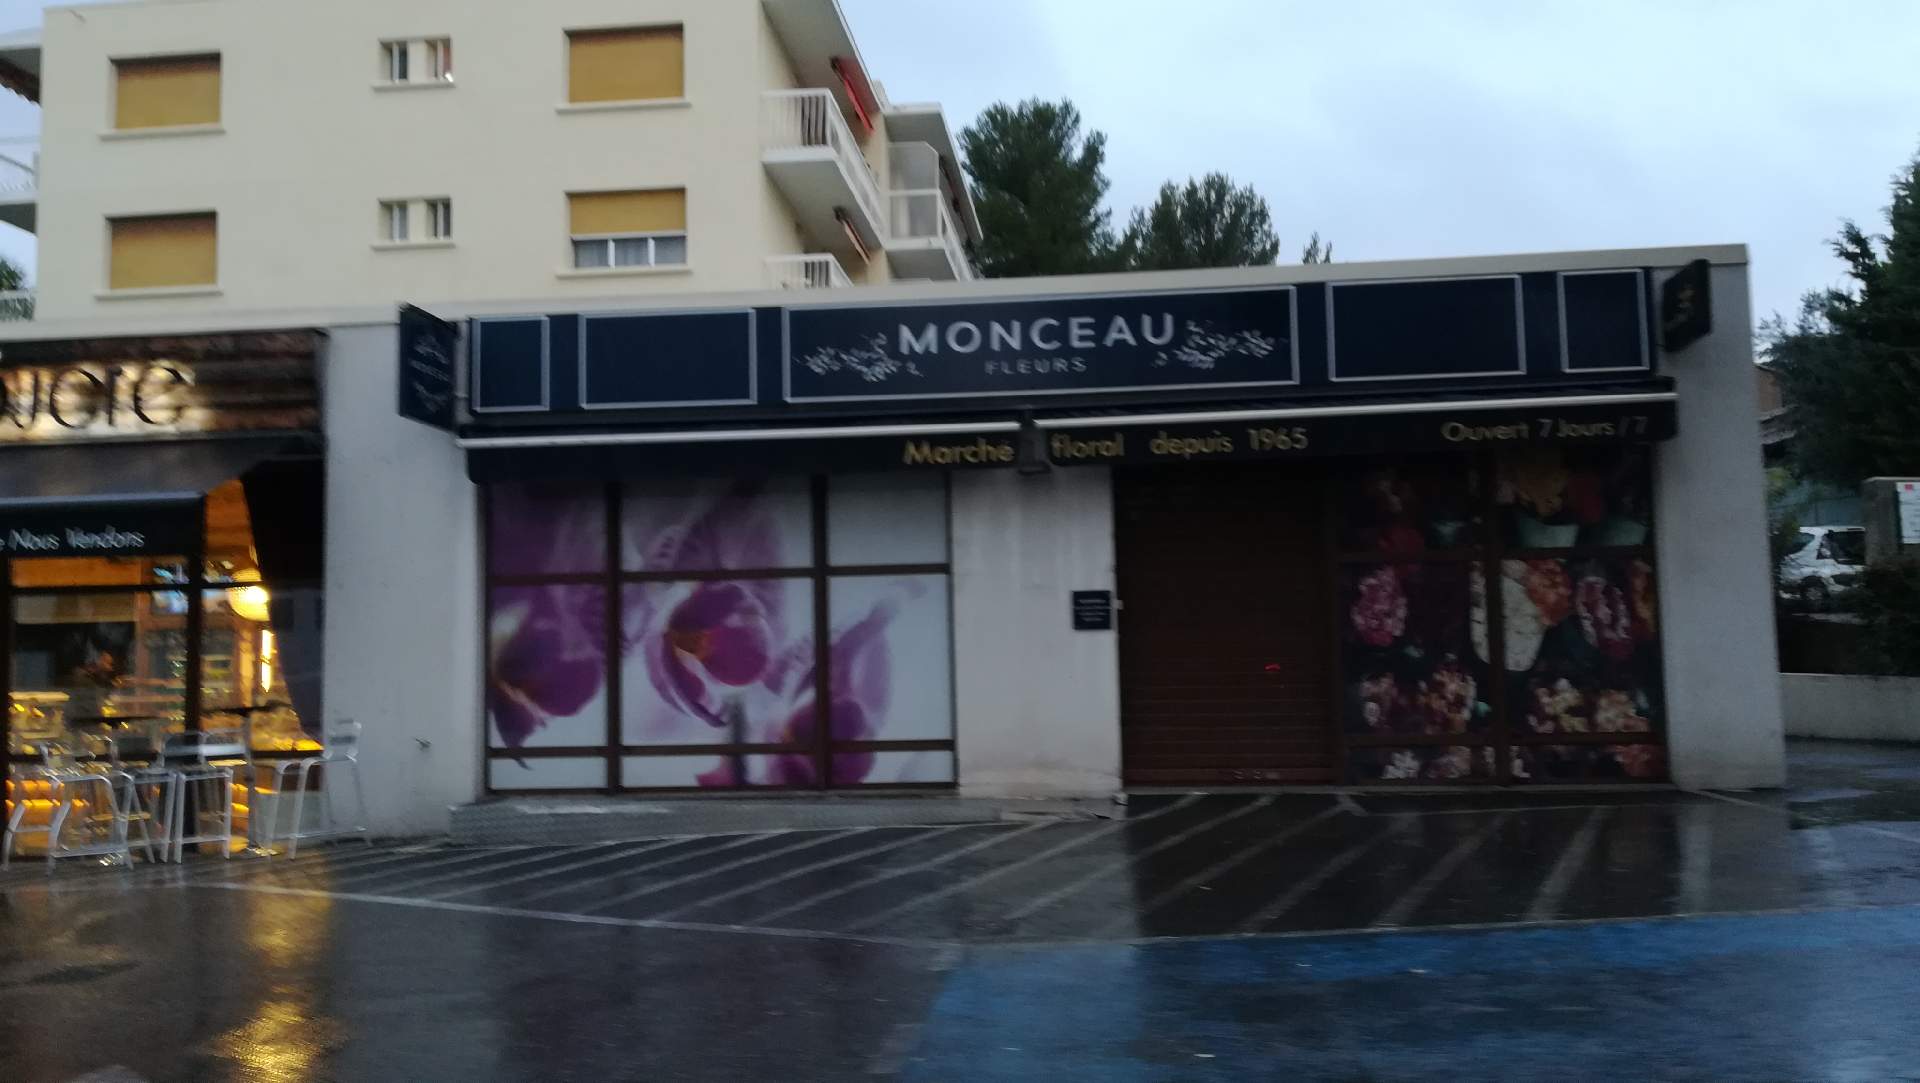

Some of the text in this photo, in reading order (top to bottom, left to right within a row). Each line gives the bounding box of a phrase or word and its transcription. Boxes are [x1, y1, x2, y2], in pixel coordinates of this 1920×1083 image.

[899, 313, 1175, 355] MONCEAU
[984, 356, 1088, 375] FLEURS
[1050, 432, 1125, 458] floral
[1150, 430, 1234, 460] depuis
[1247, 426, 1309, 452] 1965
[1440, 421, 1529, 442] Ouvert
[1536, 417, 1553, 438] 7
[1556, 417, 1616, 438] Jours
[8, 528, 61, 551] Nous
[65, 524, 145, 549] Vendons
